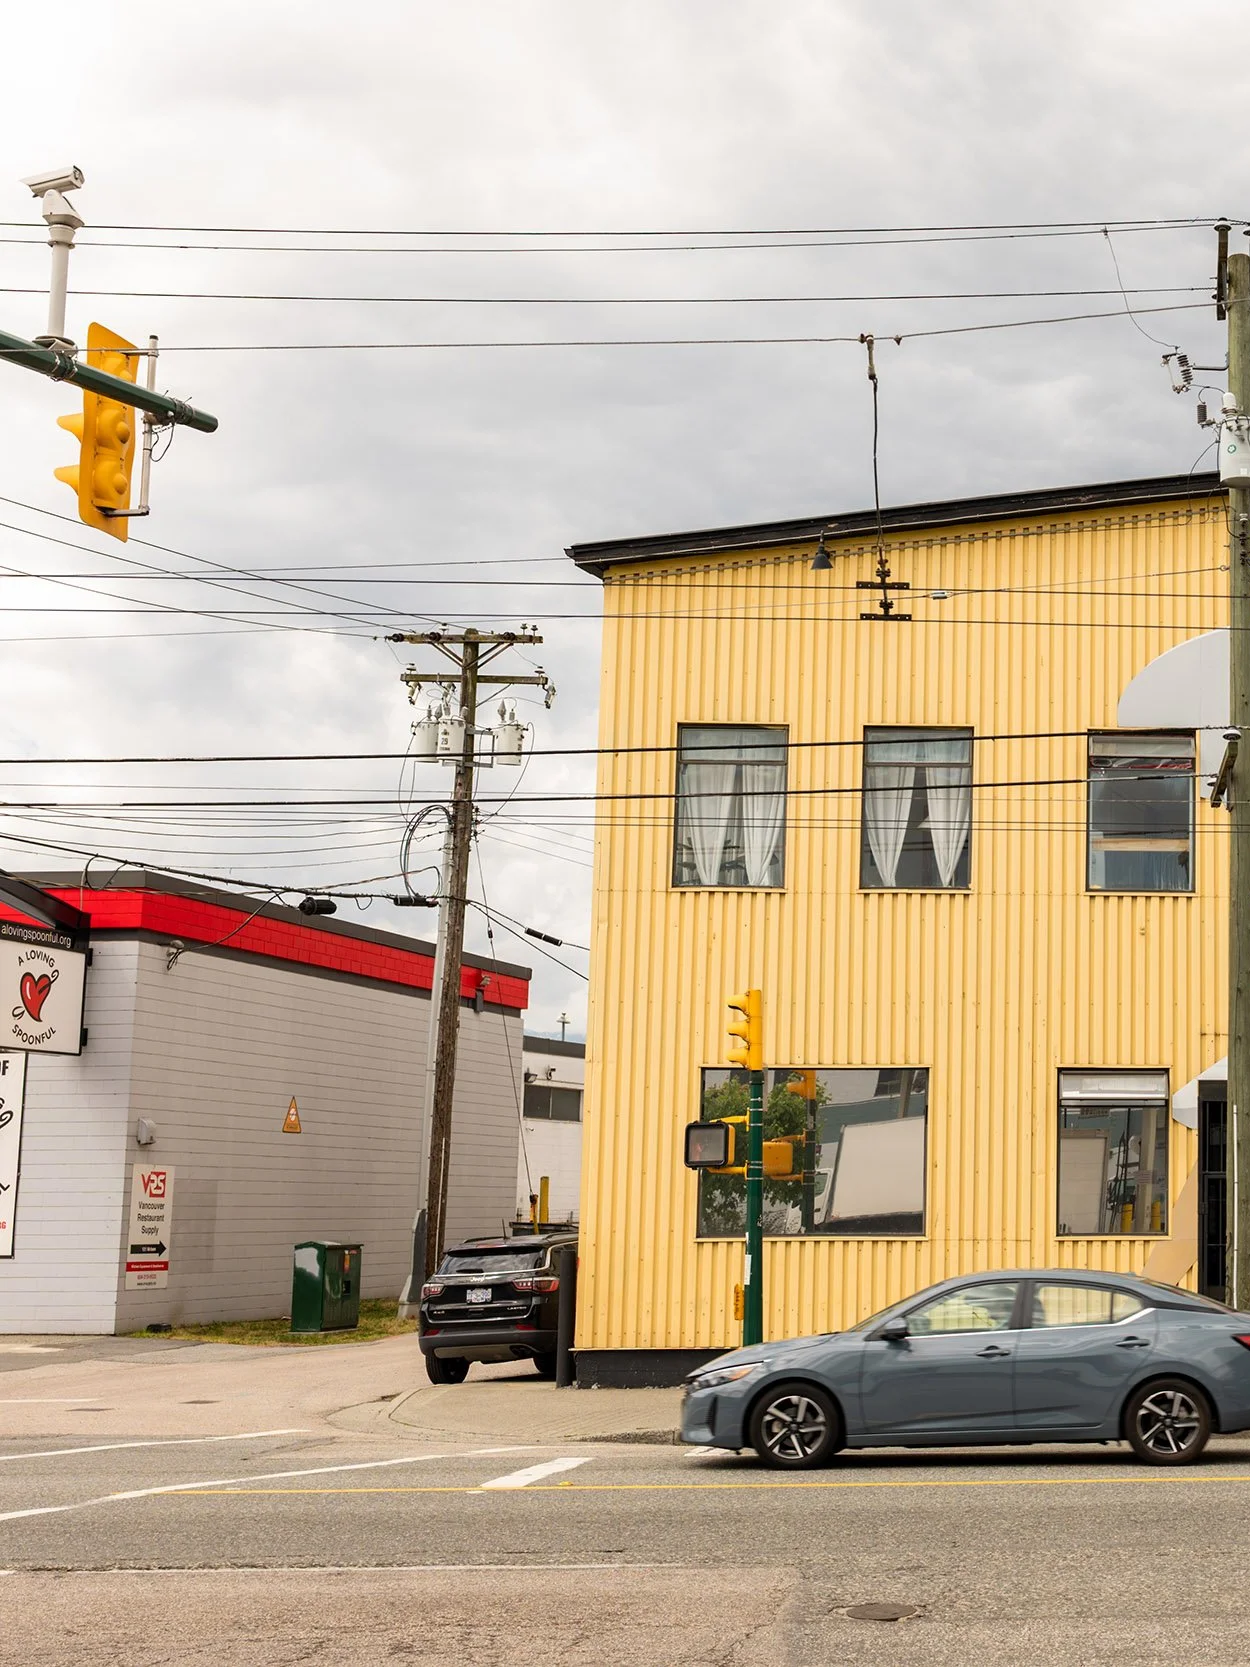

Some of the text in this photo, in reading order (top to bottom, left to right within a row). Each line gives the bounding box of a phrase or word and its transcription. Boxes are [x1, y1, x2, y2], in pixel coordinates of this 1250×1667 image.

[1, 924, 72, 949] alovingspoonful.org
[18, 949, 56, 968] A LOVING
[12, 1024, 56, 1045] SPOONFUL
[138, 1201, 166, 1210] Vancouver
[137, 1213, 165, 1222] Restaurant
[141, 1225, 160, 1236] Supply
